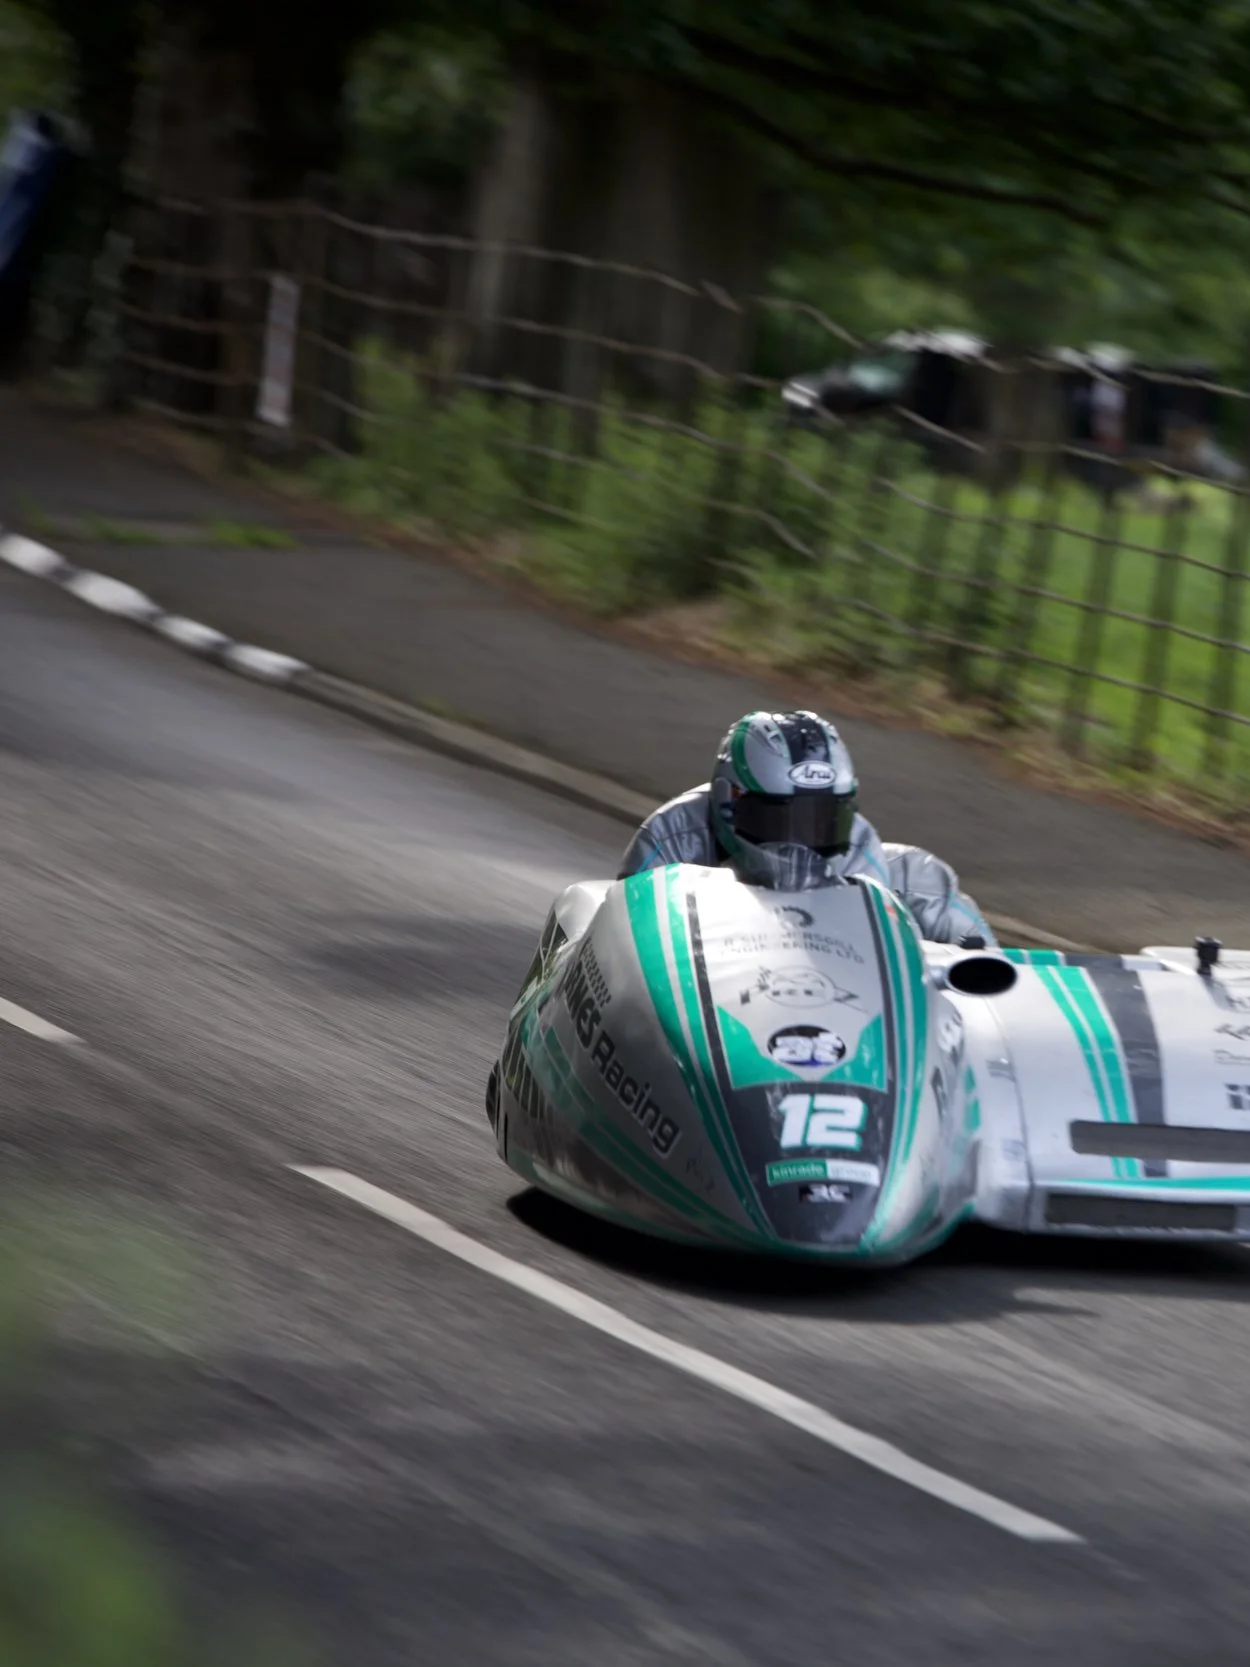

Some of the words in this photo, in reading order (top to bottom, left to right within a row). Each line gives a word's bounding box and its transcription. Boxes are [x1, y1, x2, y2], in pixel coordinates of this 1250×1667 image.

[793, 764, 831, 779] Arai
[719, 941, 832, 957] NGINERING
[592, 1031, 680, 1155] Racing
[778, 1093, 867, 1151] 12
